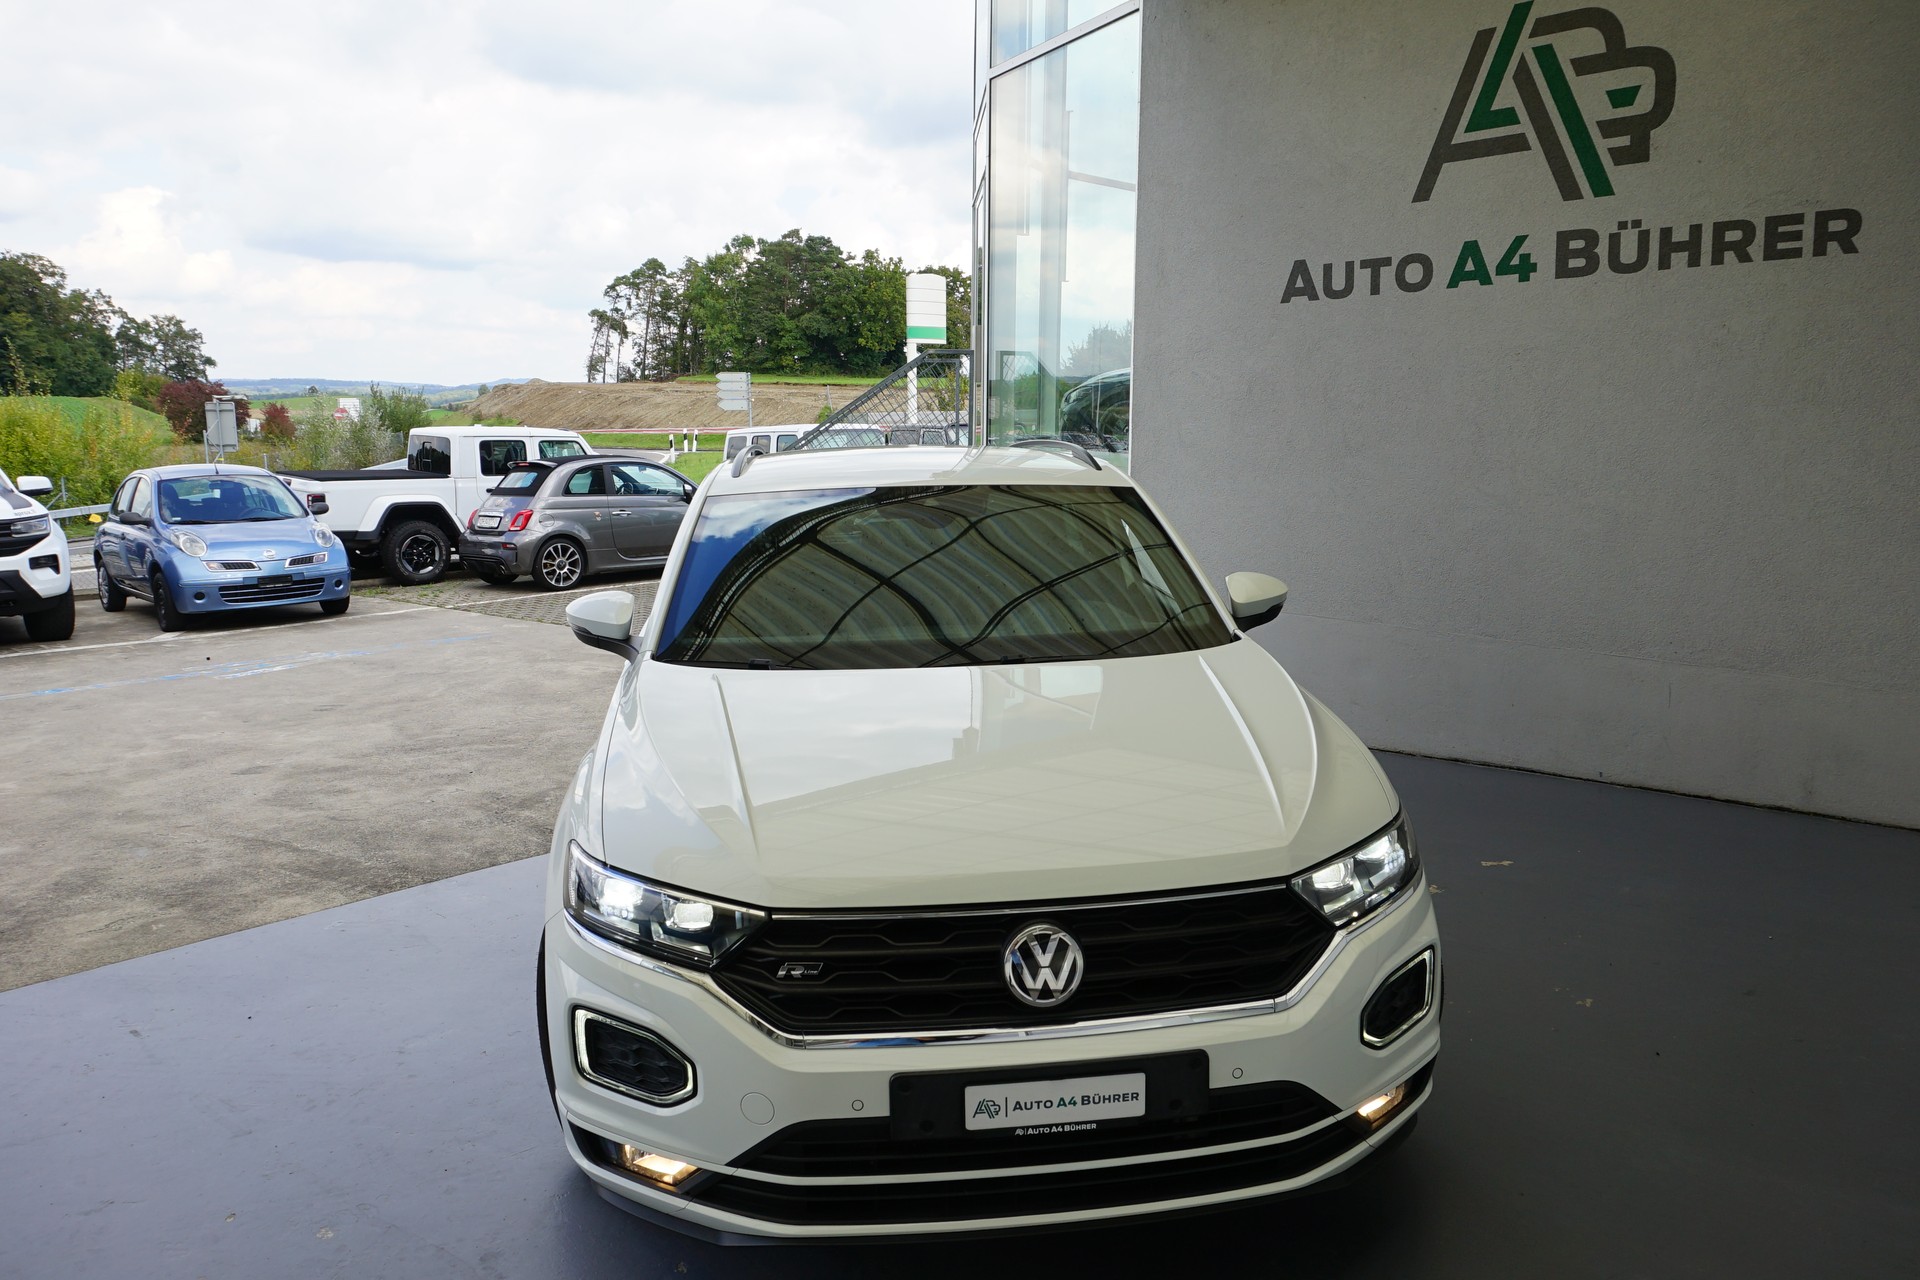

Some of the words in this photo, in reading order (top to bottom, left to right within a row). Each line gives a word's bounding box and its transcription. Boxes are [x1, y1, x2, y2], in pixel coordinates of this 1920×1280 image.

[1280, 252, 1434, 304] AUTO
[1446, 234, 1538, 289] A4
[1554, 208, 1863, 280] BÜHRER
[1005, 925, 1083, 1007] VW
[1012, 1099, 1053, 1112] AUTO
[1057, 1095, 1078, 1108] A4
[1081, 1091, 1140, 1106] BÜHRER
[1027, 1126, 1050, 1135] AUTO
[1063, 1123, 1097, 1132] BÜHRER
